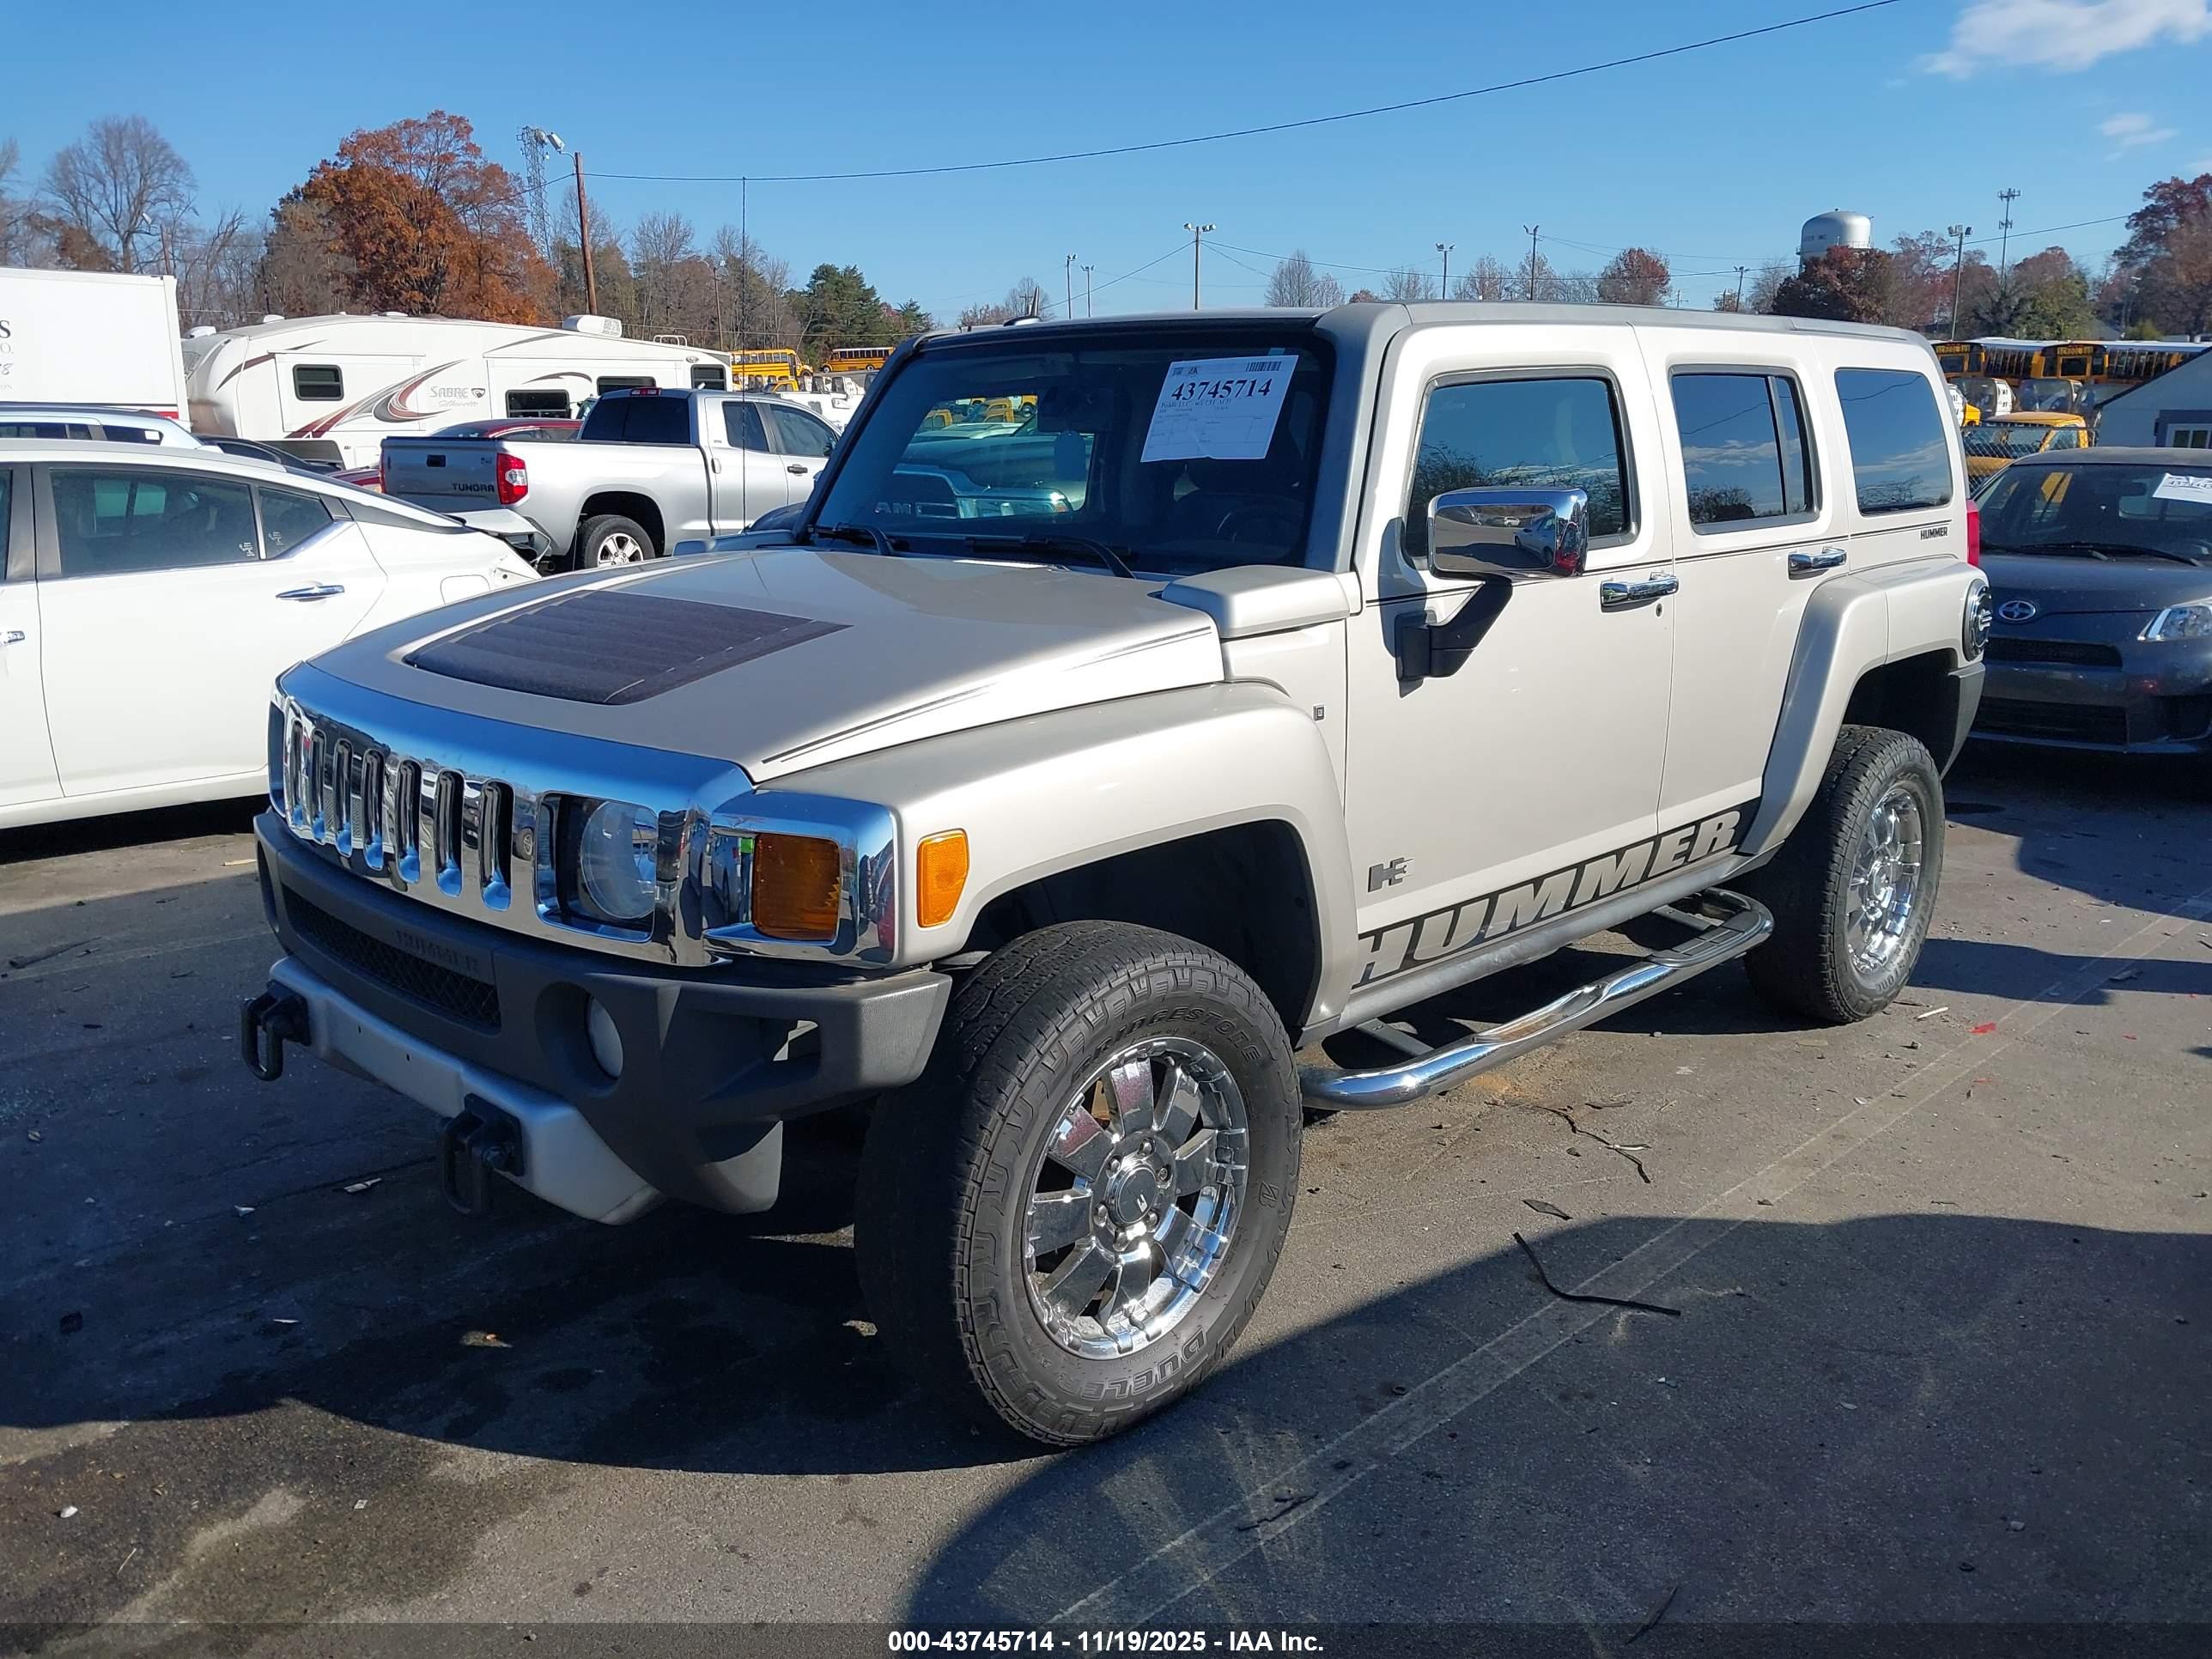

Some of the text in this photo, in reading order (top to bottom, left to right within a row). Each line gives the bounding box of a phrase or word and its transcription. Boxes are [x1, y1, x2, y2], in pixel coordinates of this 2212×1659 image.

[429, 386, 469, 398] SABRE
[1170, 378, 1273, 401] 43745714
[452, 483, 495, 493] TUNDRA
[1920, 526, 1948, 540] HUMMER
[1354, 810, 1741, 985] HUMMER
[1056, 1328, 1206, 1401] DUELER
